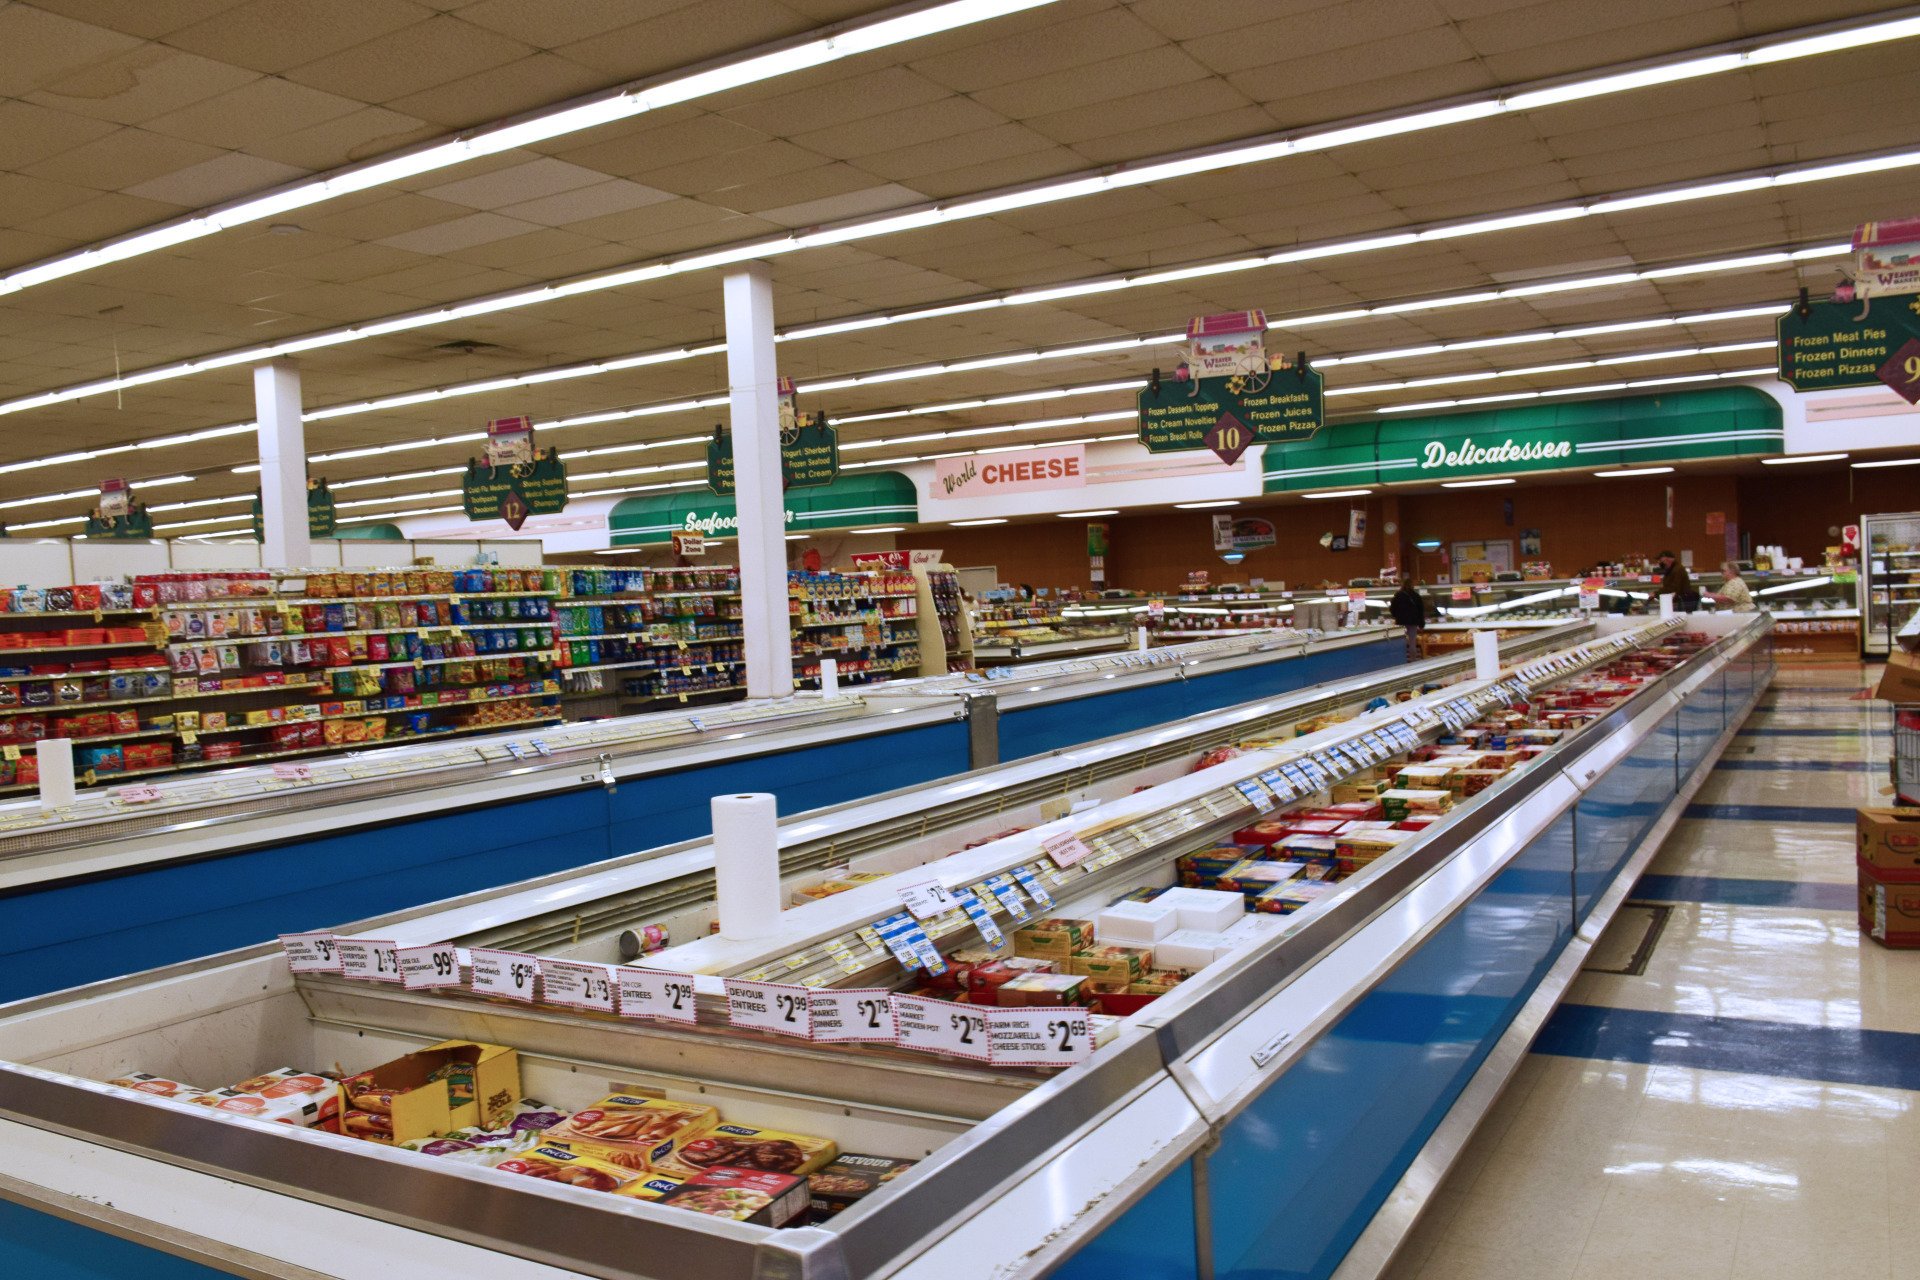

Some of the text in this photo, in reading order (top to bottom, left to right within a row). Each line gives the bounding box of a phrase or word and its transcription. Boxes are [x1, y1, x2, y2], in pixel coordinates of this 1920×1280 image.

[1794, 328, 1887, 347] Frozen Meat Pies
[1794, 344, 1887, 363] Frozen Dinners
[1203, 356, 1232, 369] WEAVER
[1795, 363, 1876, 379] Frozen Pizzas
[1903, 356, 1920, 385] 9
[1243, 393, 1309, 407] Frozen Breakfasts
[1148, 402, 1219, 416] Frozen Desserts Toppings
[1250, 407, 1313, 420] Frozen Juices
[1147, 416, 1217, 430] Ice Cream Novelties
[1258, 421, 1317, 433] Frozen Pizzas
[1149, 430, 1204, 443] Frozen Bread Rolls
[1216, 427, 1240, 450] 10
[1420, 437, 1572, 470] Delicatessen
[794, 469, 833, 479] Ice Cream
[942, 457, 1080, 495] World CHEESE
[506, 502, 520, 519] 12
[684, 545, 701, 553] Zone
[342, 952, 368, 960] EVERYDAY
[374, 948, 384, 972] 2
[475, 965, 501, 976] Sandwich
[475, 976, 493, 985] Steaks
[583, 977, 592, 999] 2
[622, 990, 652, 999] ENTREES
[729, 987, 764, 1000] DEVOUR
[731, 1000, 767, 1013] ENTREES
[812, 1009, 839, 1017] MARKET
[899, 1002, 924, 1011] BOSTON
[900, 1012, 925, 1020] MARKET
[814, 1020, 843, 1028] DINNERS
[900, 1020, 926, 1030] CHICKEN
[989, 1021, 1011, 1029] FARM
[991, 1031, 1041, 1039] MOZZARELLA
[992, 1043, 1020, 1051] CHEESE
[837, 1155, 894, 1168] DEVOUR
